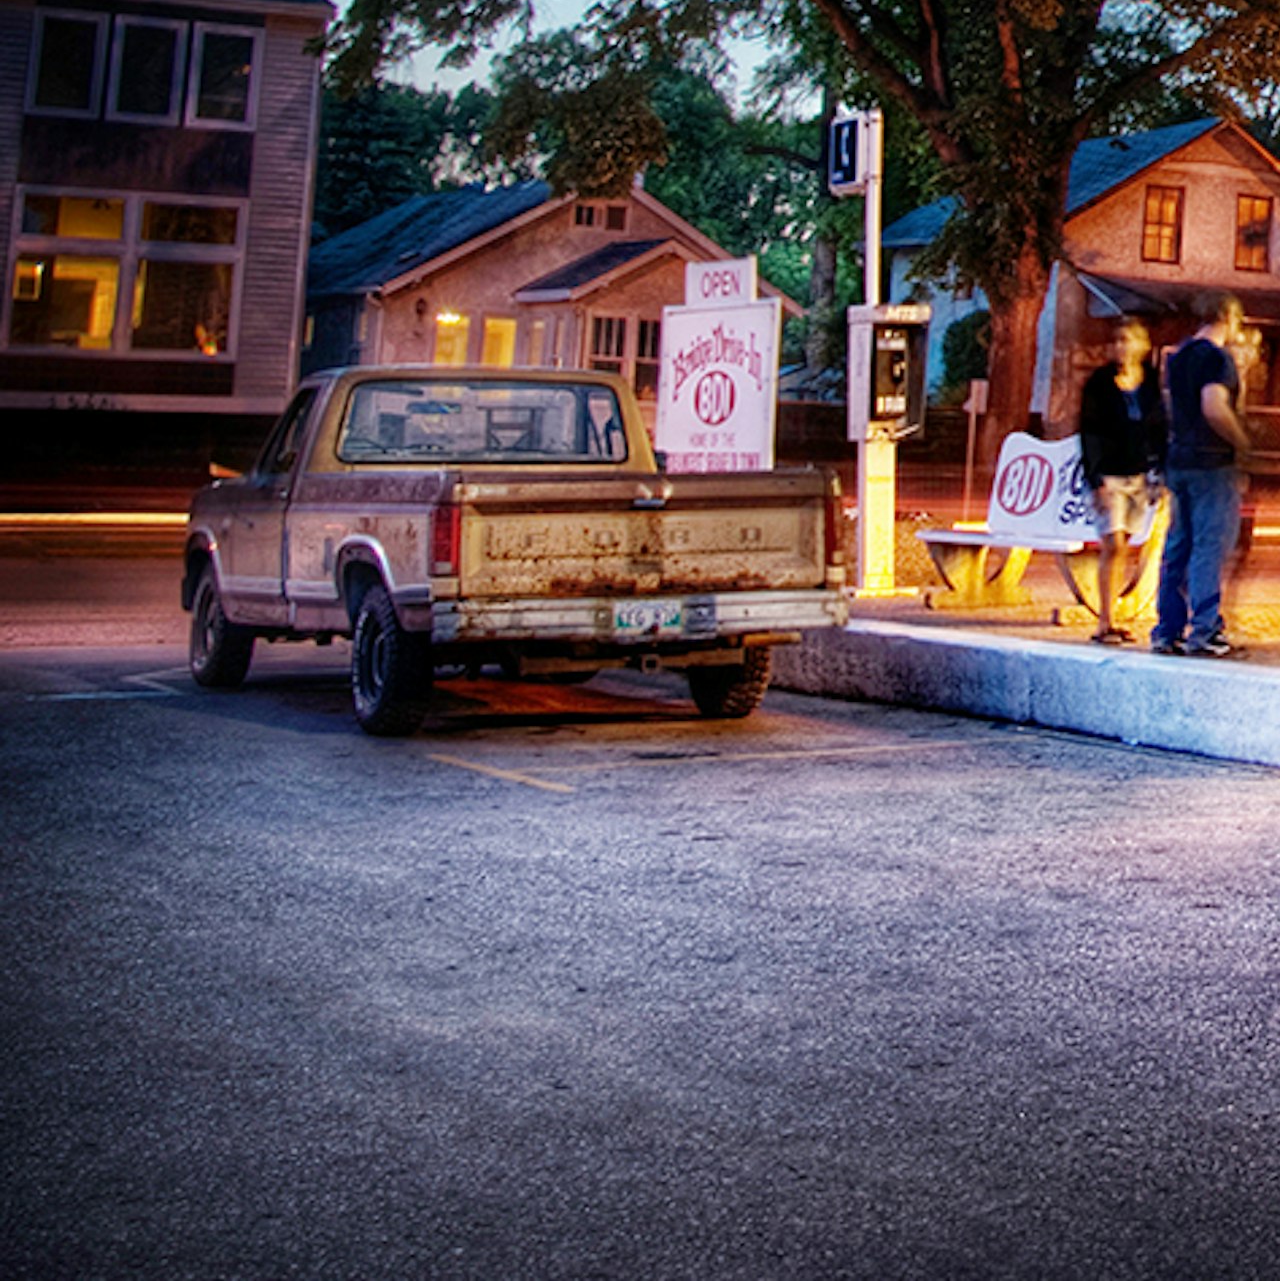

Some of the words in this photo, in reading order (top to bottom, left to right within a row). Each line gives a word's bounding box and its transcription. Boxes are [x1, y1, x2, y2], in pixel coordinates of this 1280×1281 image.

[701, 270, 741, 298] OPEN
[699, 374, 731, 423] BDI
[1003, 456, 1049, 513] BDI
